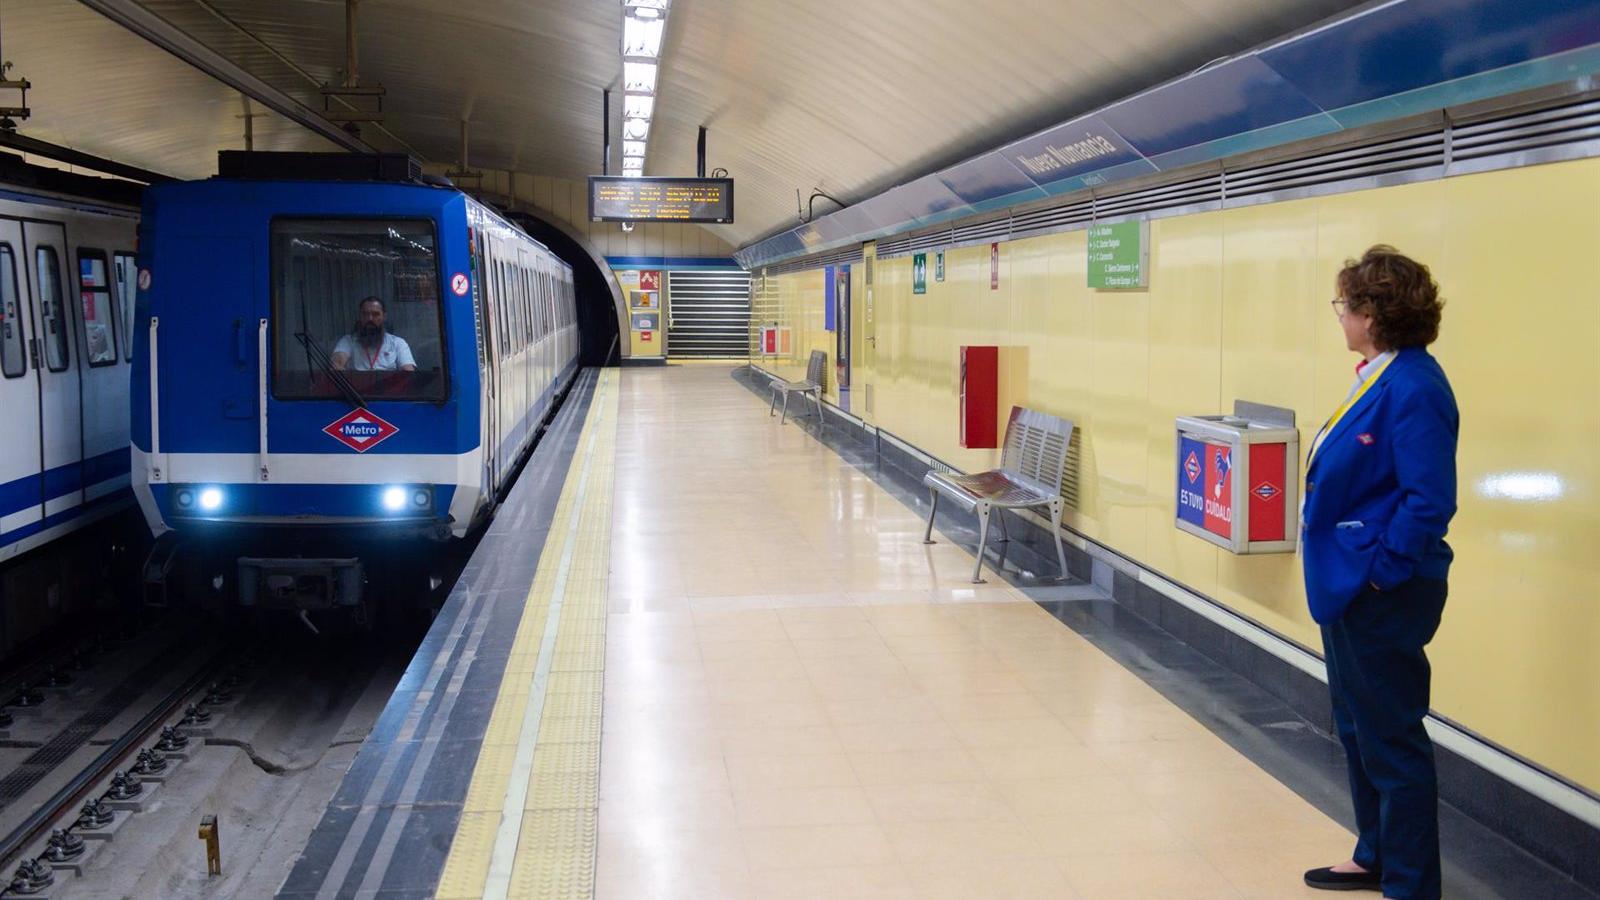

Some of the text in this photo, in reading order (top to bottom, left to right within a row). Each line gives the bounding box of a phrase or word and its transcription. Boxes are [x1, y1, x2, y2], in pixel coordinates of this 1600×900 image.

[1017, 132, 1118, 174] Nueva Numancia
[345, 425, 377, 435] Metro
[1181, 489, 1203, 511] ES TUYO
